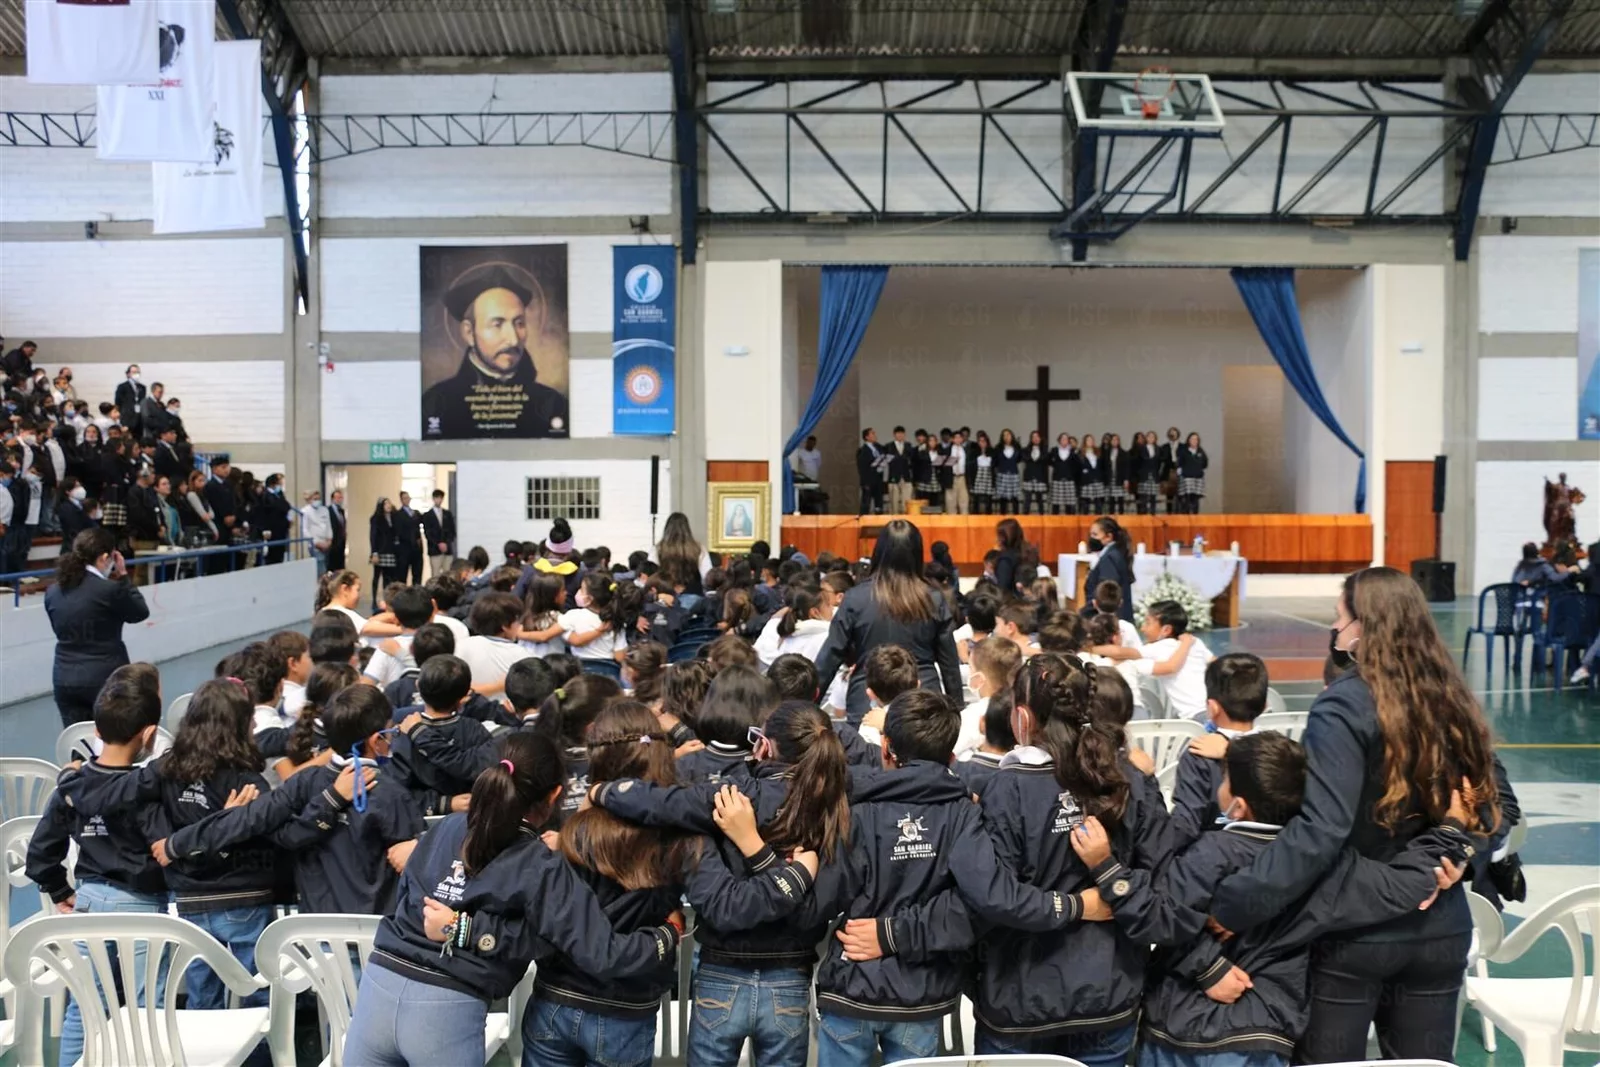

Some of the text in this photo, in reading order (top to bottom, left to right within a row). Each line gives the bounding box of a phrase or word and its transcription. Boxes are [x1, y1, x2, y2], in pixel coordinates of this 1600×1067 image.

[148, 90, 165, 101] XXI
[372, 444, 406, 460] SALIDA
[893, 843, 932, 853] SAN GABRIEL
